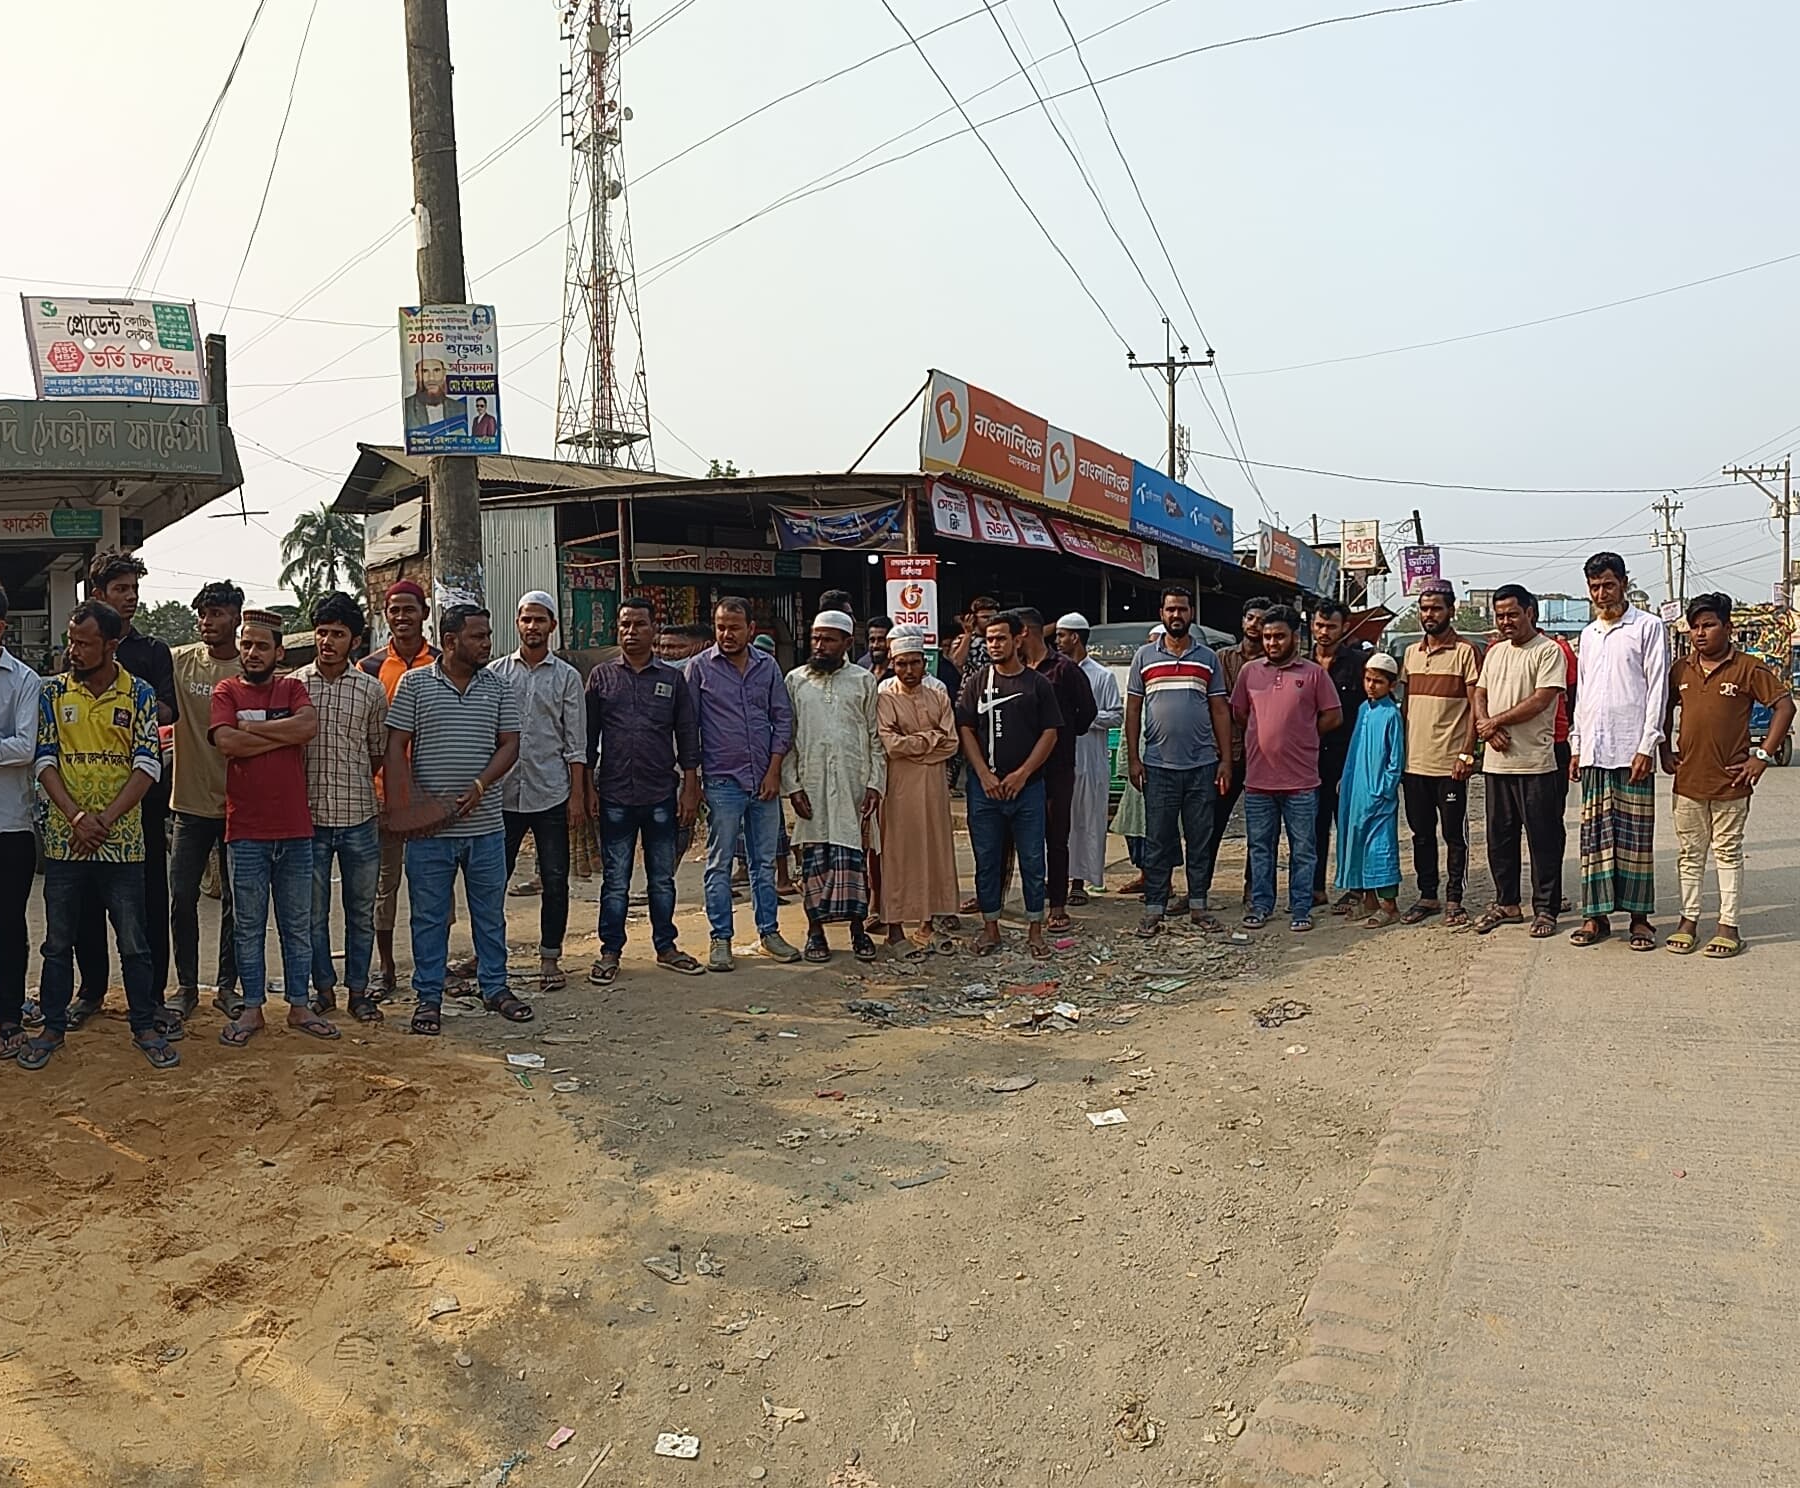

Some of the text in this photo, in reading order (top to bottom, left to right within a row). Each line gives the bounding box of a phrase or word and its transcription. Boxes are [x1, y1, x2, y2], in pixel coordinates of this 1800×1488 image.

[408, 332, 444, 344] 2026
[88, 345, 126, 369] ভর্তি
[32, 410, 116, 457] সেন্ট্রাল
[123, 406, 209, 458] ফার্মেসী
[973, 414, 1043, 459] বাংলালিংক
[1078, 458, 1130, 492] বাংলালিংক
[2, 512, 48, 534] ফার্মেসী
[986, 522, 1013, 537] নগদ
[895, 611, 929, 626] নগদ
